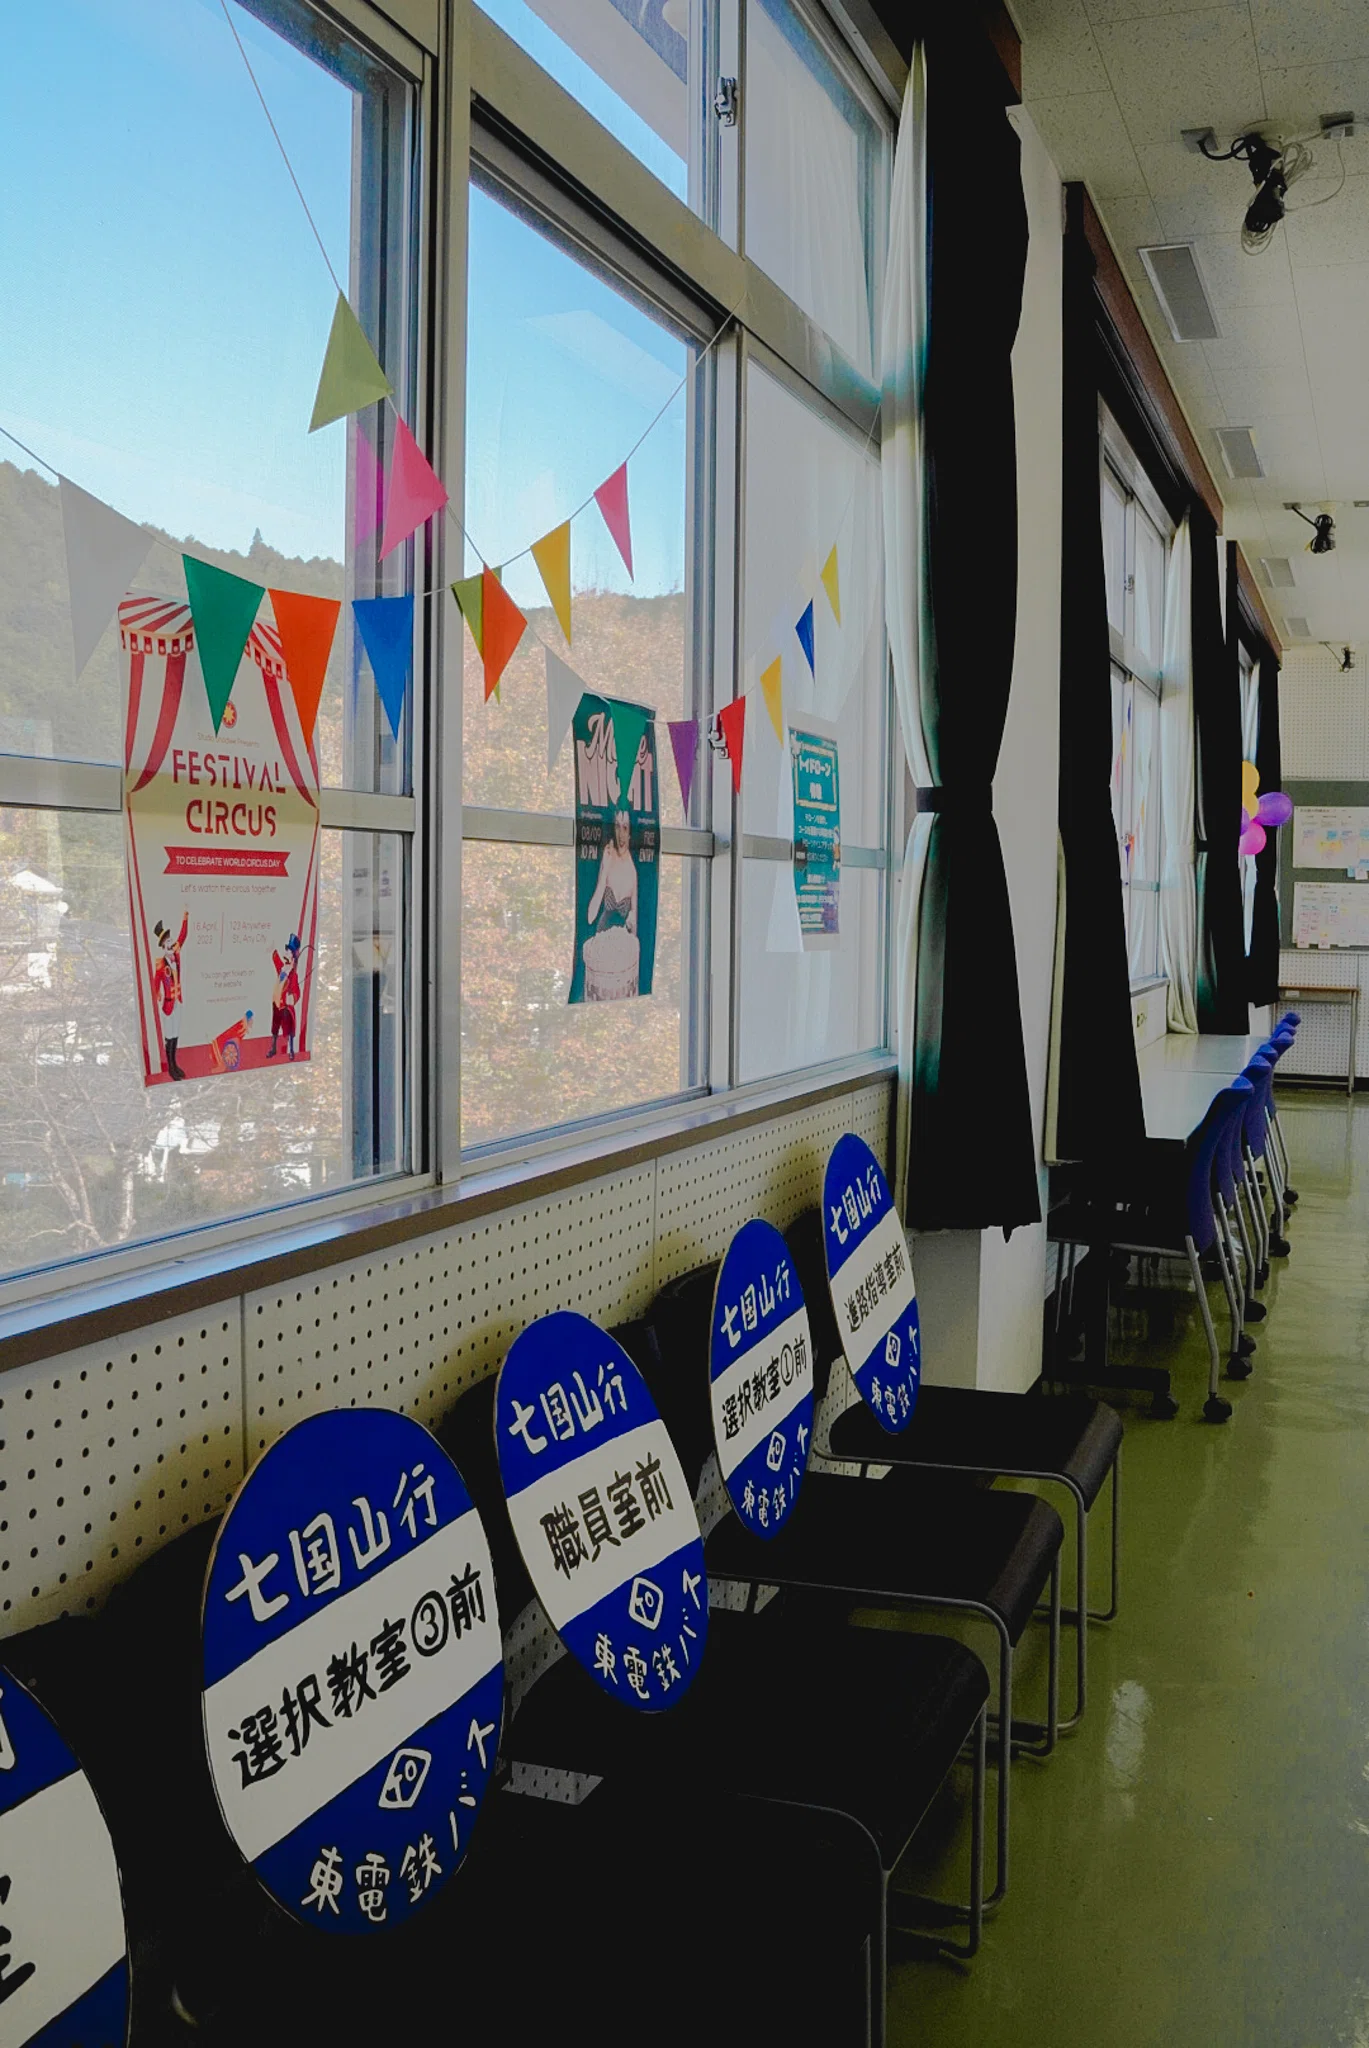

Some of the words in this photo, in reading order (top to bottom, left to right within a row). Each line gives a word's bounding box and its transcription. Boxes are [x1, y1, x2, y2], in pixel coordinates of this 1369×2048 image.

[172, 749, 286, 794] FESTIVAL
[175, 856, 185, 865] TO
[186, 856, 223, 867] CELEBRATE
[223, 857, 246, 867] WORLD
[246, 858, 268, 868] CIRCUS
[269, 859, 281, 868] DAY
[186, 799, 277, 837] CIRCUS
[180, 884, 197, 893] Let's
[198, 884, 219, 893] watch
[219, 884, 231, 893] the
[232, 885, 251, 893] circus
[251, 885, 277, 896] together
[830, 1164, 882, 1244] 七国山行
[721, 1260, 790, 1347] 七国山行
[844, 1241, 906, 1333] 進路指導室前
[508, 1362, 628, 1454] 七国山行
[722, 1333, 808, 1441] 選択教室①前
[225, 1463, 438, 1622] 七国山行
[539, 1452, 675, 1580] 職員室前
[227, 1562, 487, 1790] 選択教室③前
